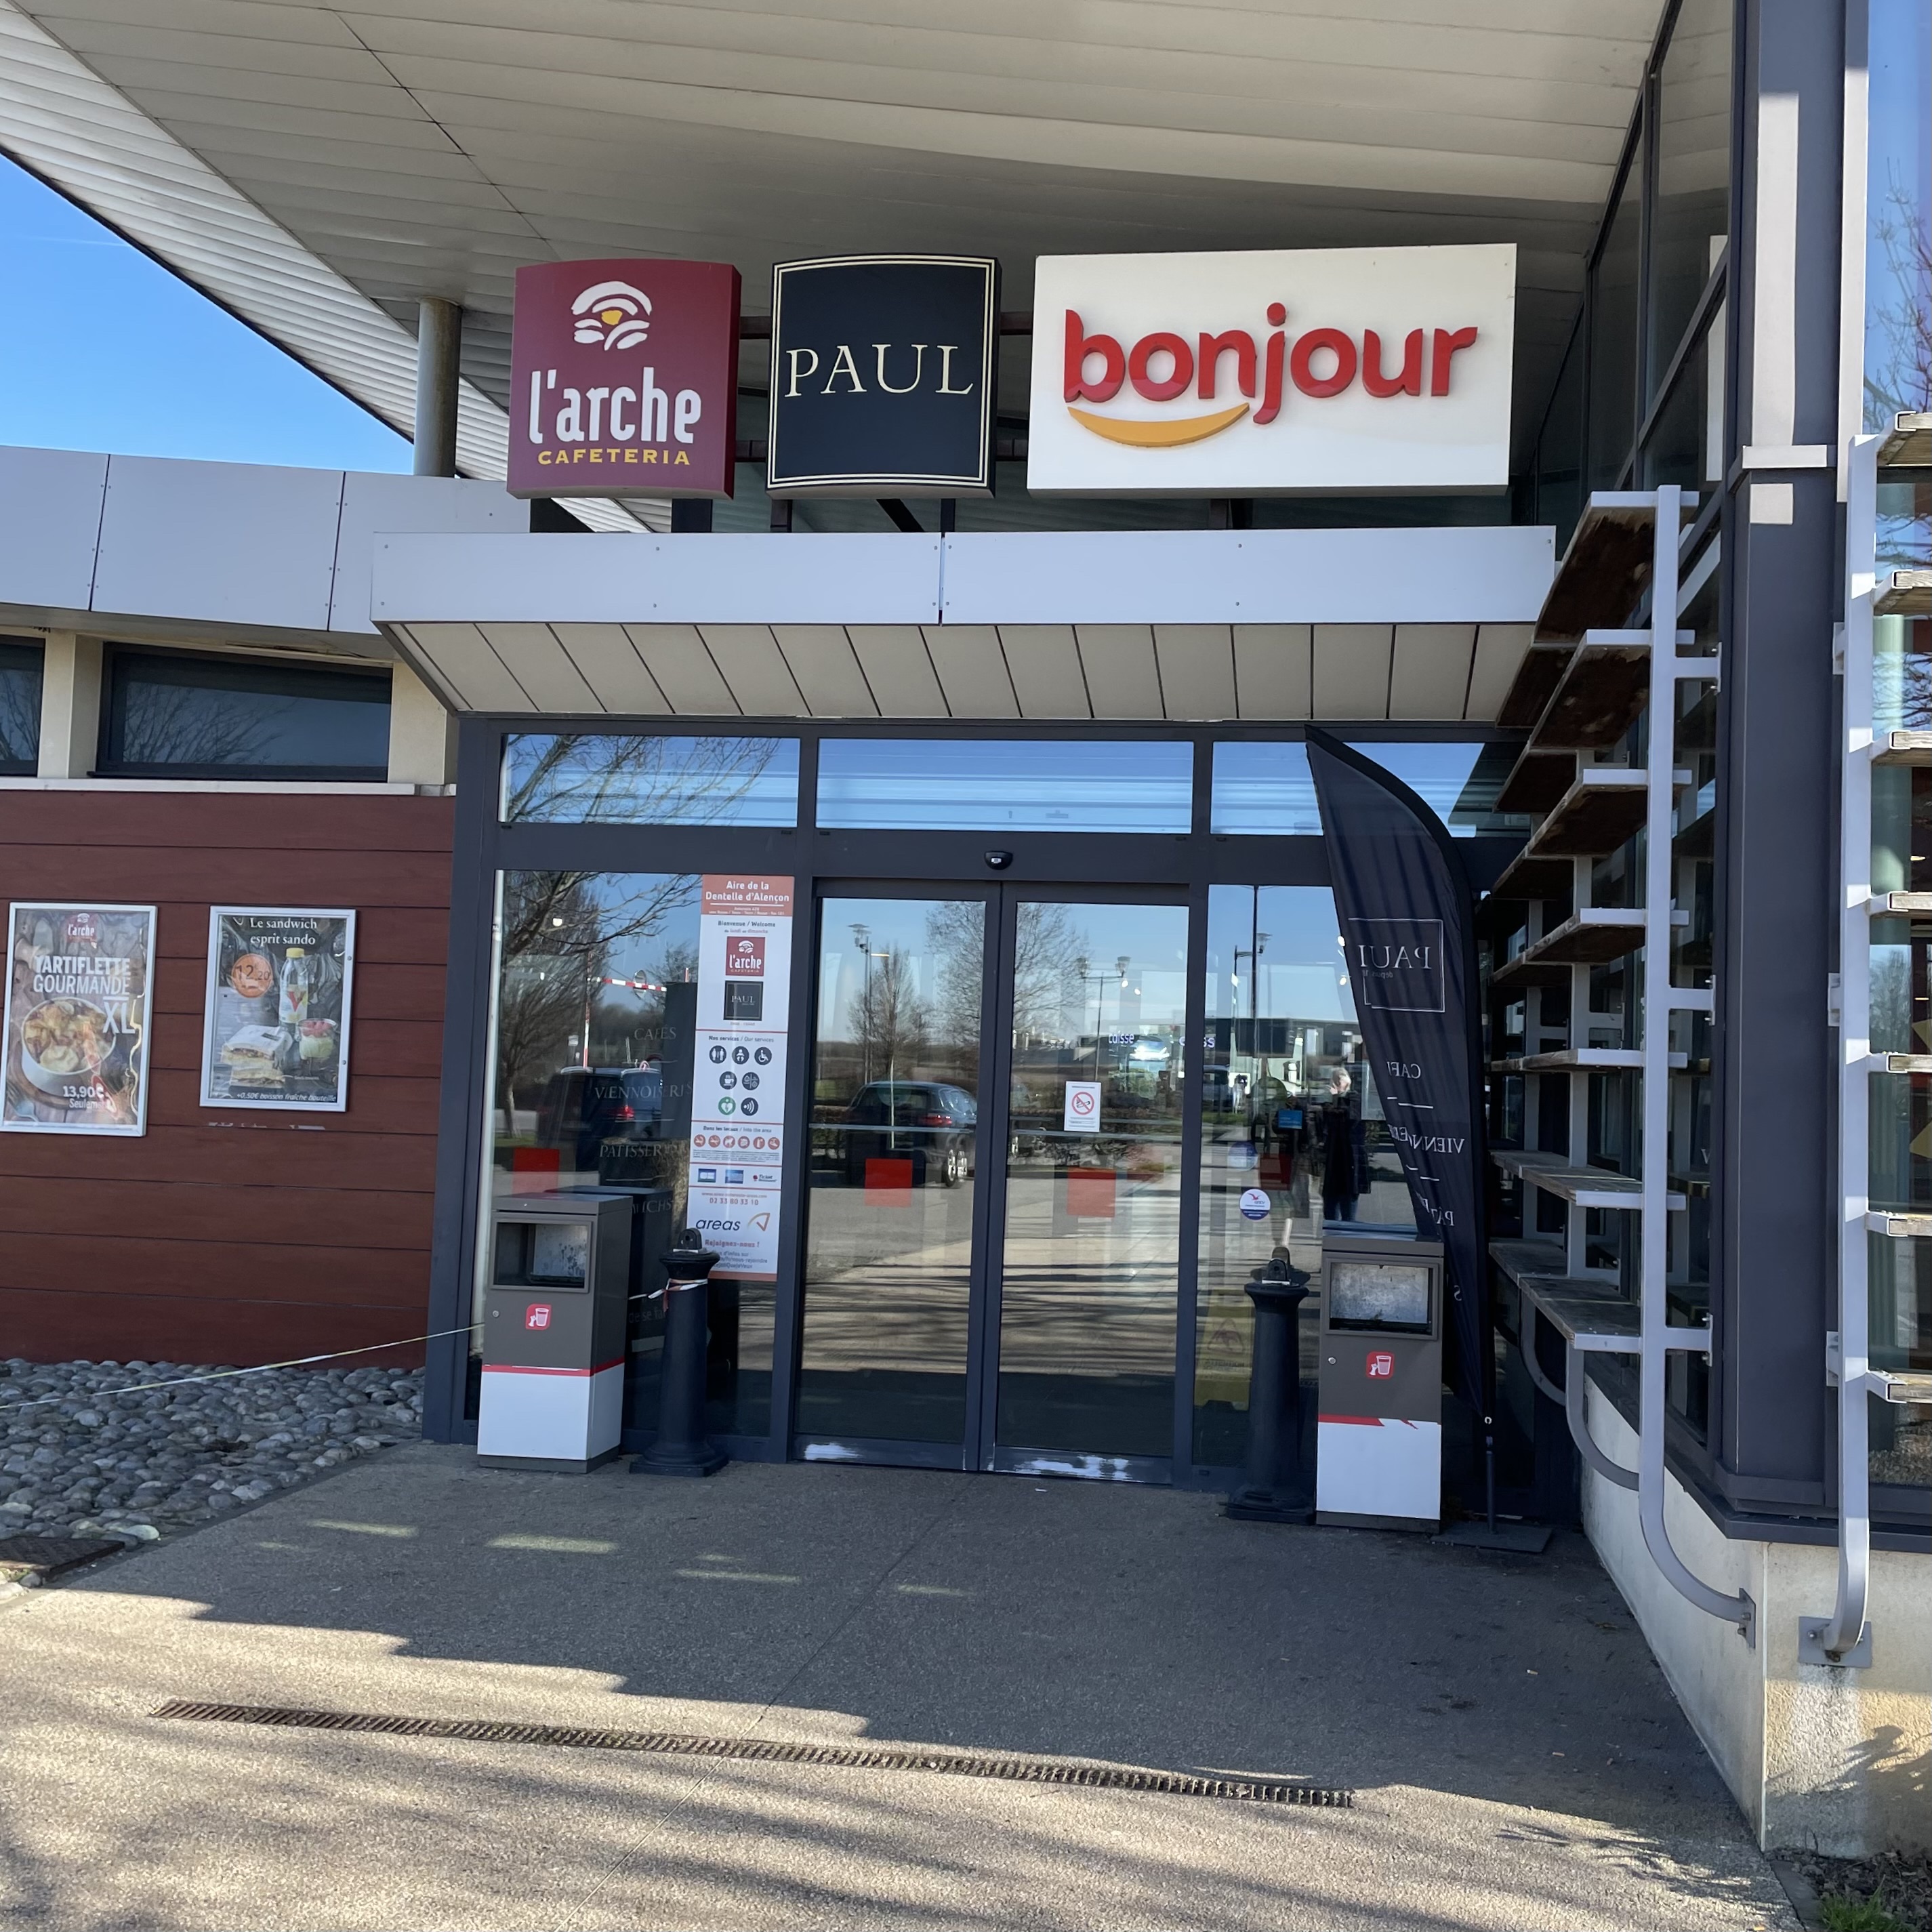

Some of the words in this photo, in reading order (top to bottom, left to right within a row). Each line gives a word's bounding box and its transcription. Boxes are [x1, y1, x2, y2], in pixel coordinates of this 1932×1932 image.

[785, 344, 974, 398] PAUL
[1063, 302, 1478, 425] bonjour
[529, 367, 701, 444] l'arche
[537, 448, 691, 466] CAFETERIA
[726, 881, 745, 890] Aire
[747, 881, 758, 890] de
[761, 882, 769, 890] la
[705, 891, 743, 901] Dentelle
[746, 892, 789, 904] d'Alençon
[68, 924, 95, 937] l'arche
[249, 917, 264, 928] Le
[266, 918, 317, 929] sandwich
[250, 932, 281, 947] esprit
[282, 934, 316, 945] sando
[35, 955, 131, 976] TARTIFLETTE
[729, 954, 762, 969] l'arche
[34, 974, 131, 995] GOURMANDE
[103, 1002, 136, 1034] XL
[1108, 1031, 1135, 1044] caisse
[695, 1219, 741, 1231] areas
